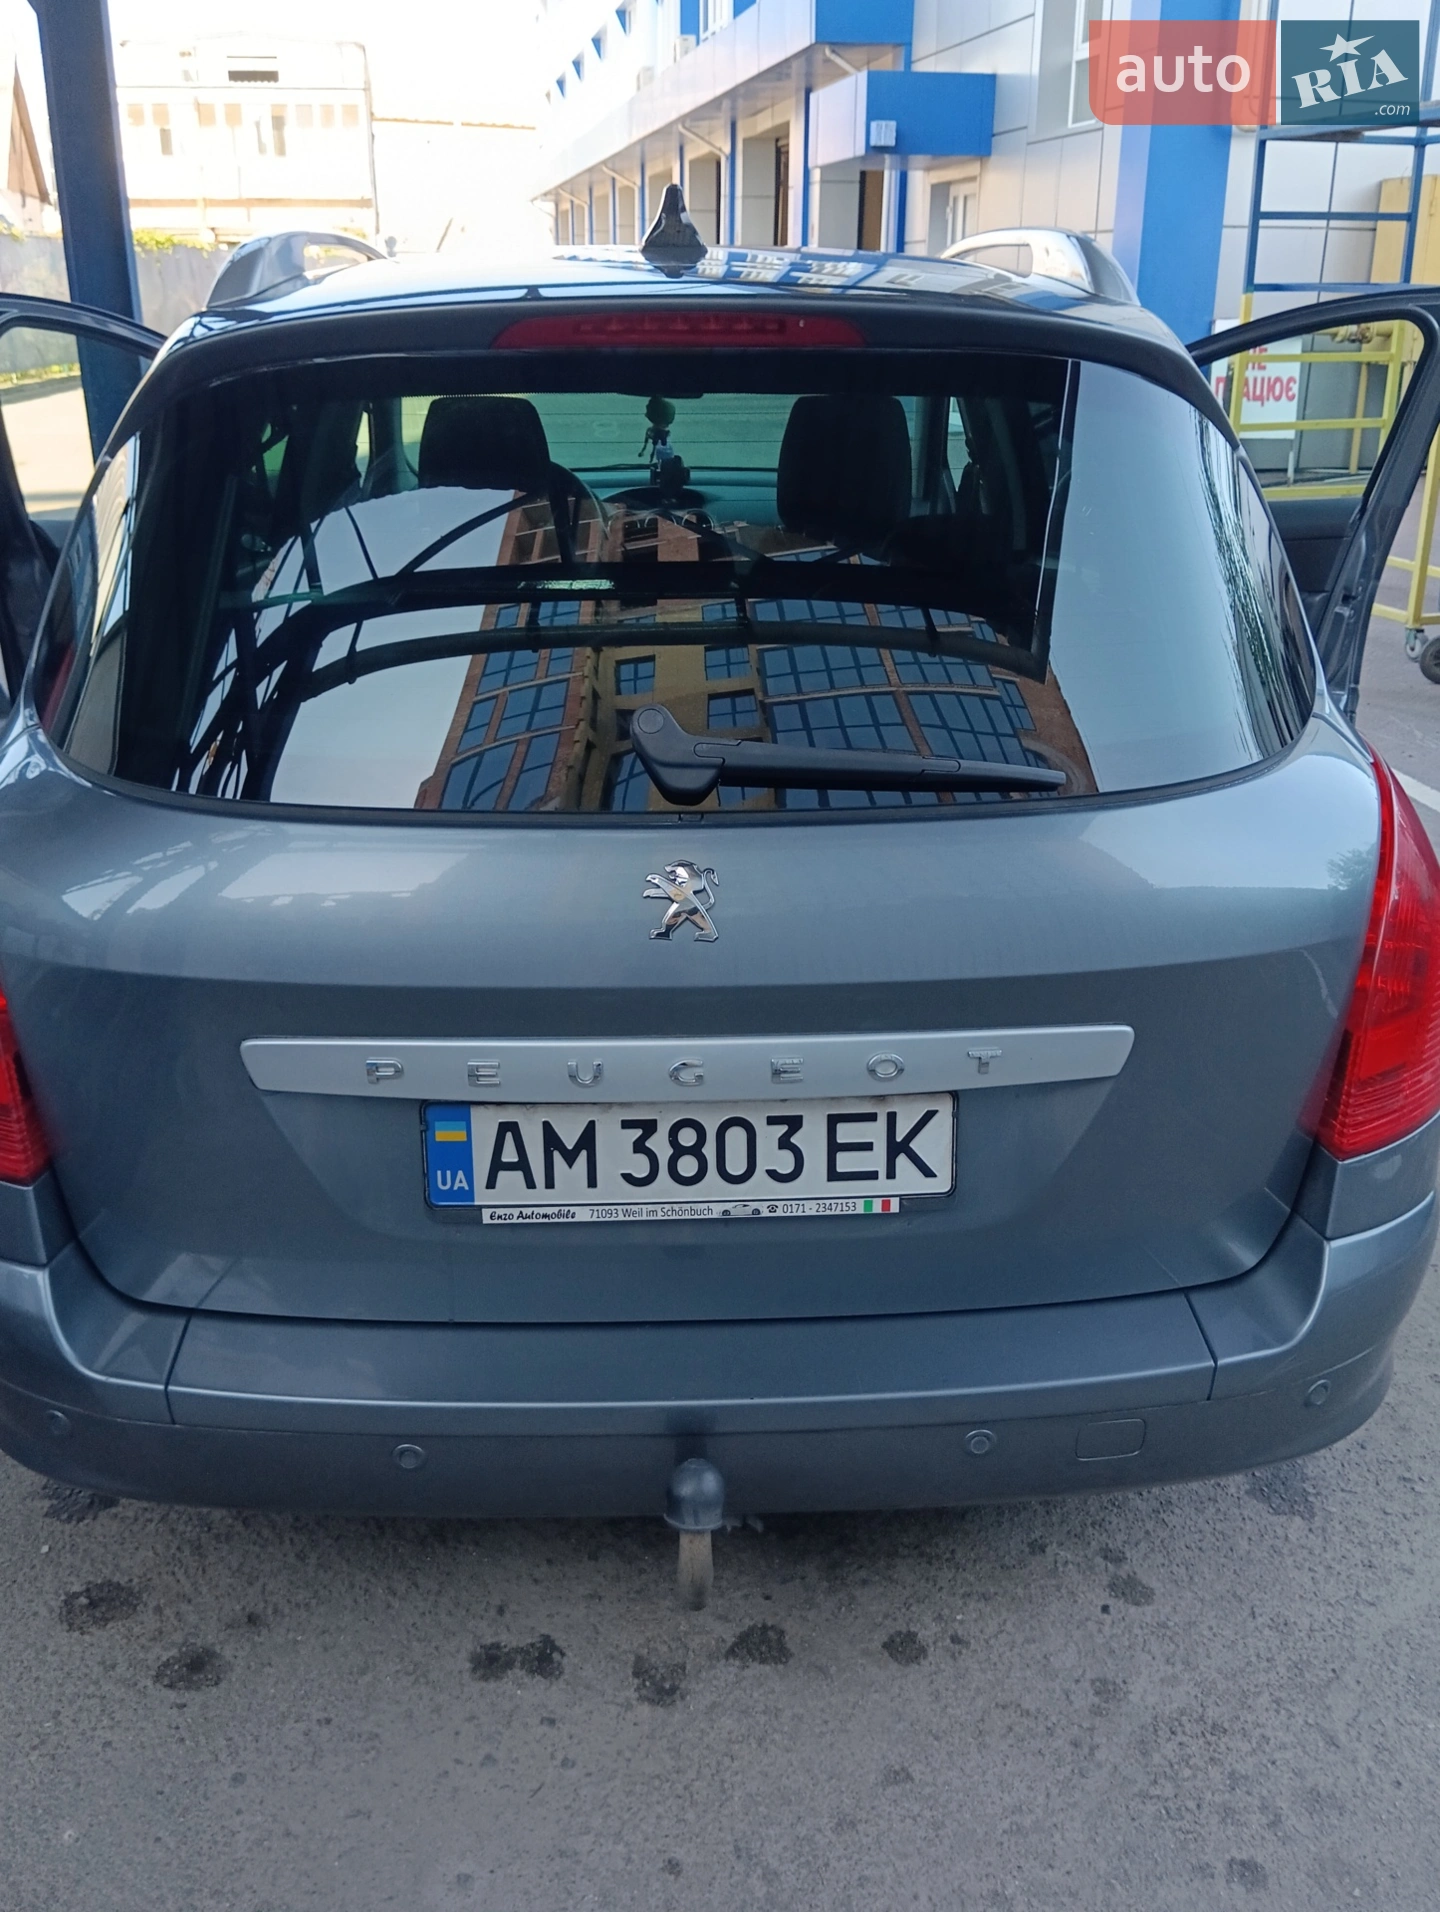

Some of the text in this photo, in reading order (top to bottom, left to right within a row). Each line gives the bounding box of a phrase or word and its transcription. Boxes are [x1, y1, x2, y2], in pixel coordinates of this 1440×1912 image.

[1215, 375, 1297, 407] ПАЦЮЄ
[365, 1047, 1002, 1088] PEUGEOT
[485, 1109, 940, 1190] AM 3803 EK
[436, 1169, 470, 1191] UA
[489, 1210, 514, 1221] Enzo
[516, 1209, 576, 1220] Automobile
[589, 1208, 619, 1219] 71093
[622, 1207, 643, 1218] Weil
[645, 1207, 658, 1218] im
[660, 1203, 714, 1218] Schönbuch
[782, 1203, 806, 1214] 0171
[815, 1201, 857, 1213] 2347153
